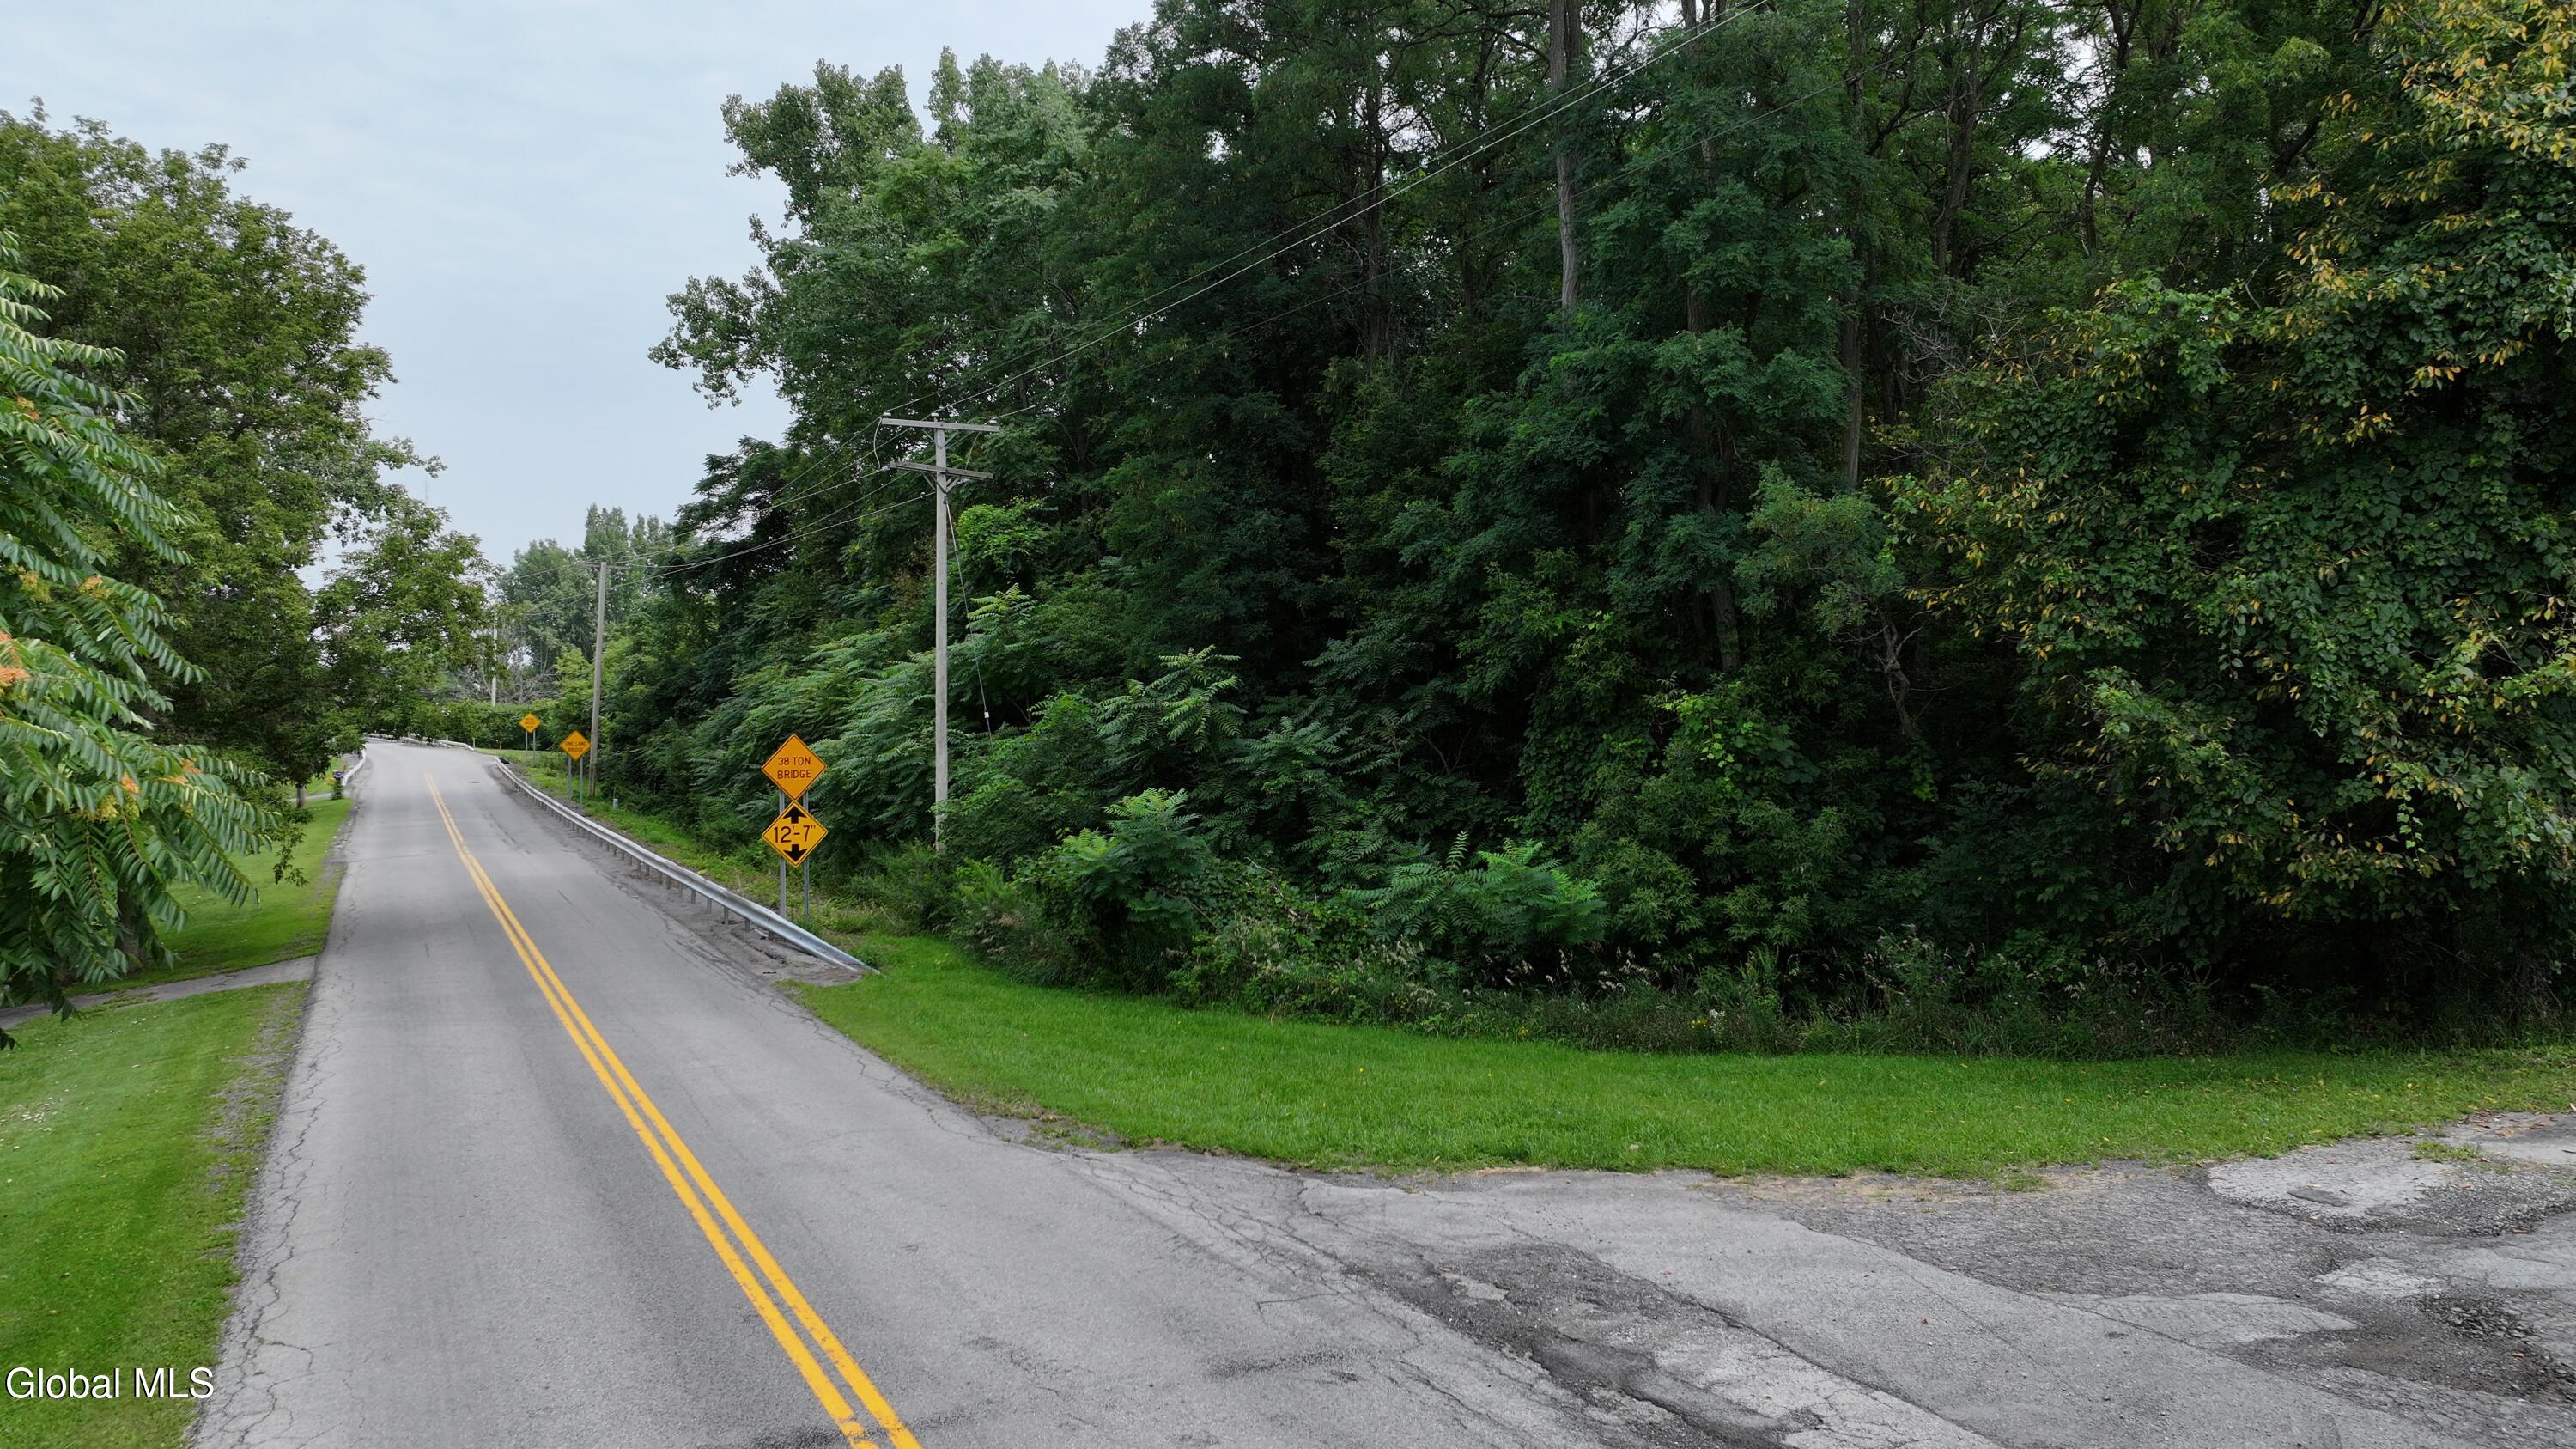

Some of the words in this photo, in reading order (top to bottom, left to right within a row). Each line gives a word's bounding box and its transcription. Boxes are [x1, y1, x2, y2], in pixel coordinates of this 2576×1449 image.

[778, 757, 790, 766] 38
[792, 756, 811, 766] TON
[777, 770, 811, 780] BRIDGE
